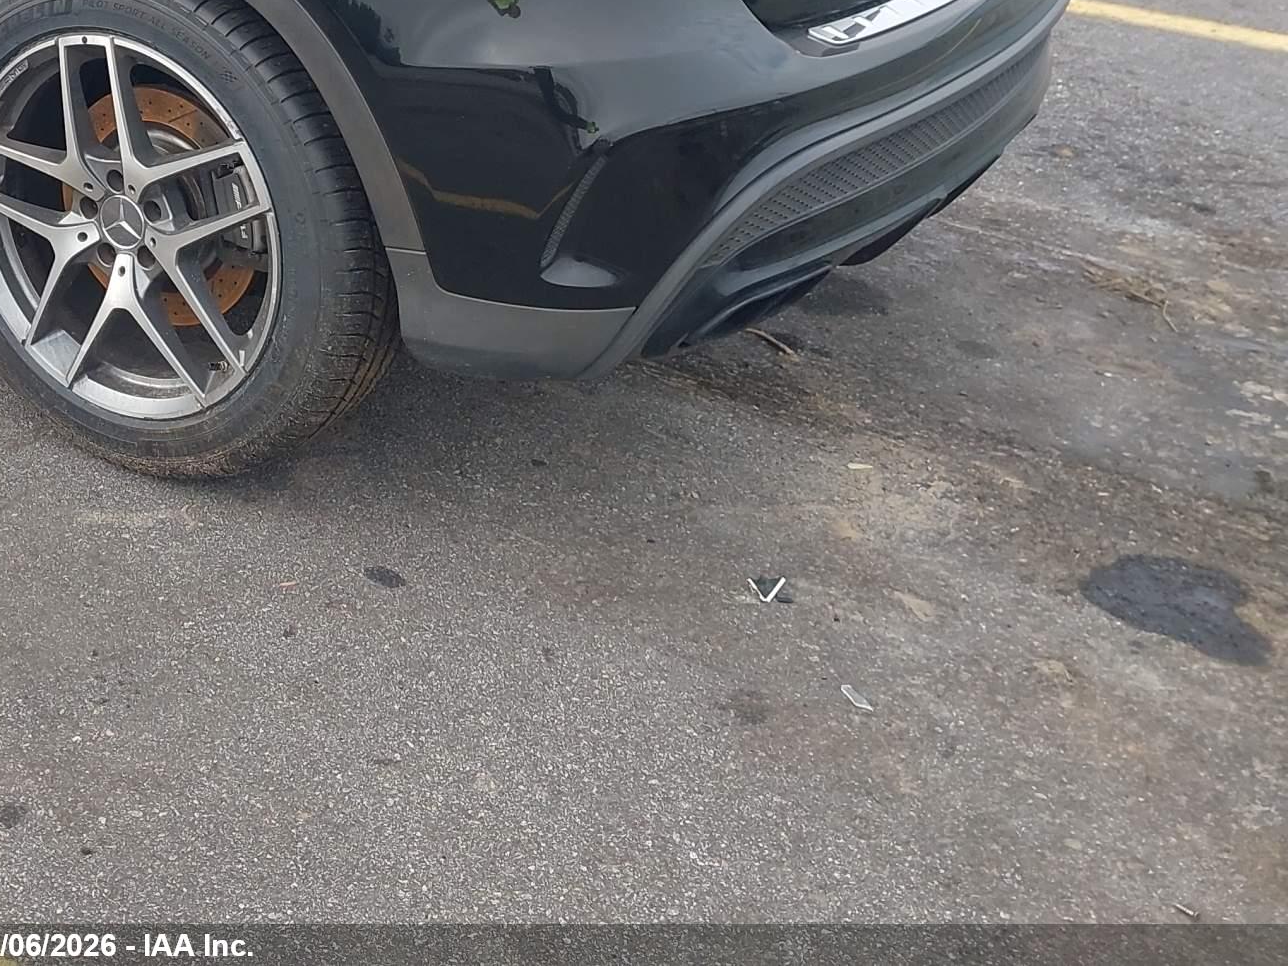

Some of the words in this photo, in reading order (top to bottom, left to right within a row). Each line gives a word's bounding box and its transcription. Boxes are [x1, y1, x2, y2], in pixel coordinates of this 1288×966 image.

[112, 1, 145, 20] SPORT
[149, 16, 166, 31] ALL
[172, 25, 212, 60] SEASON
